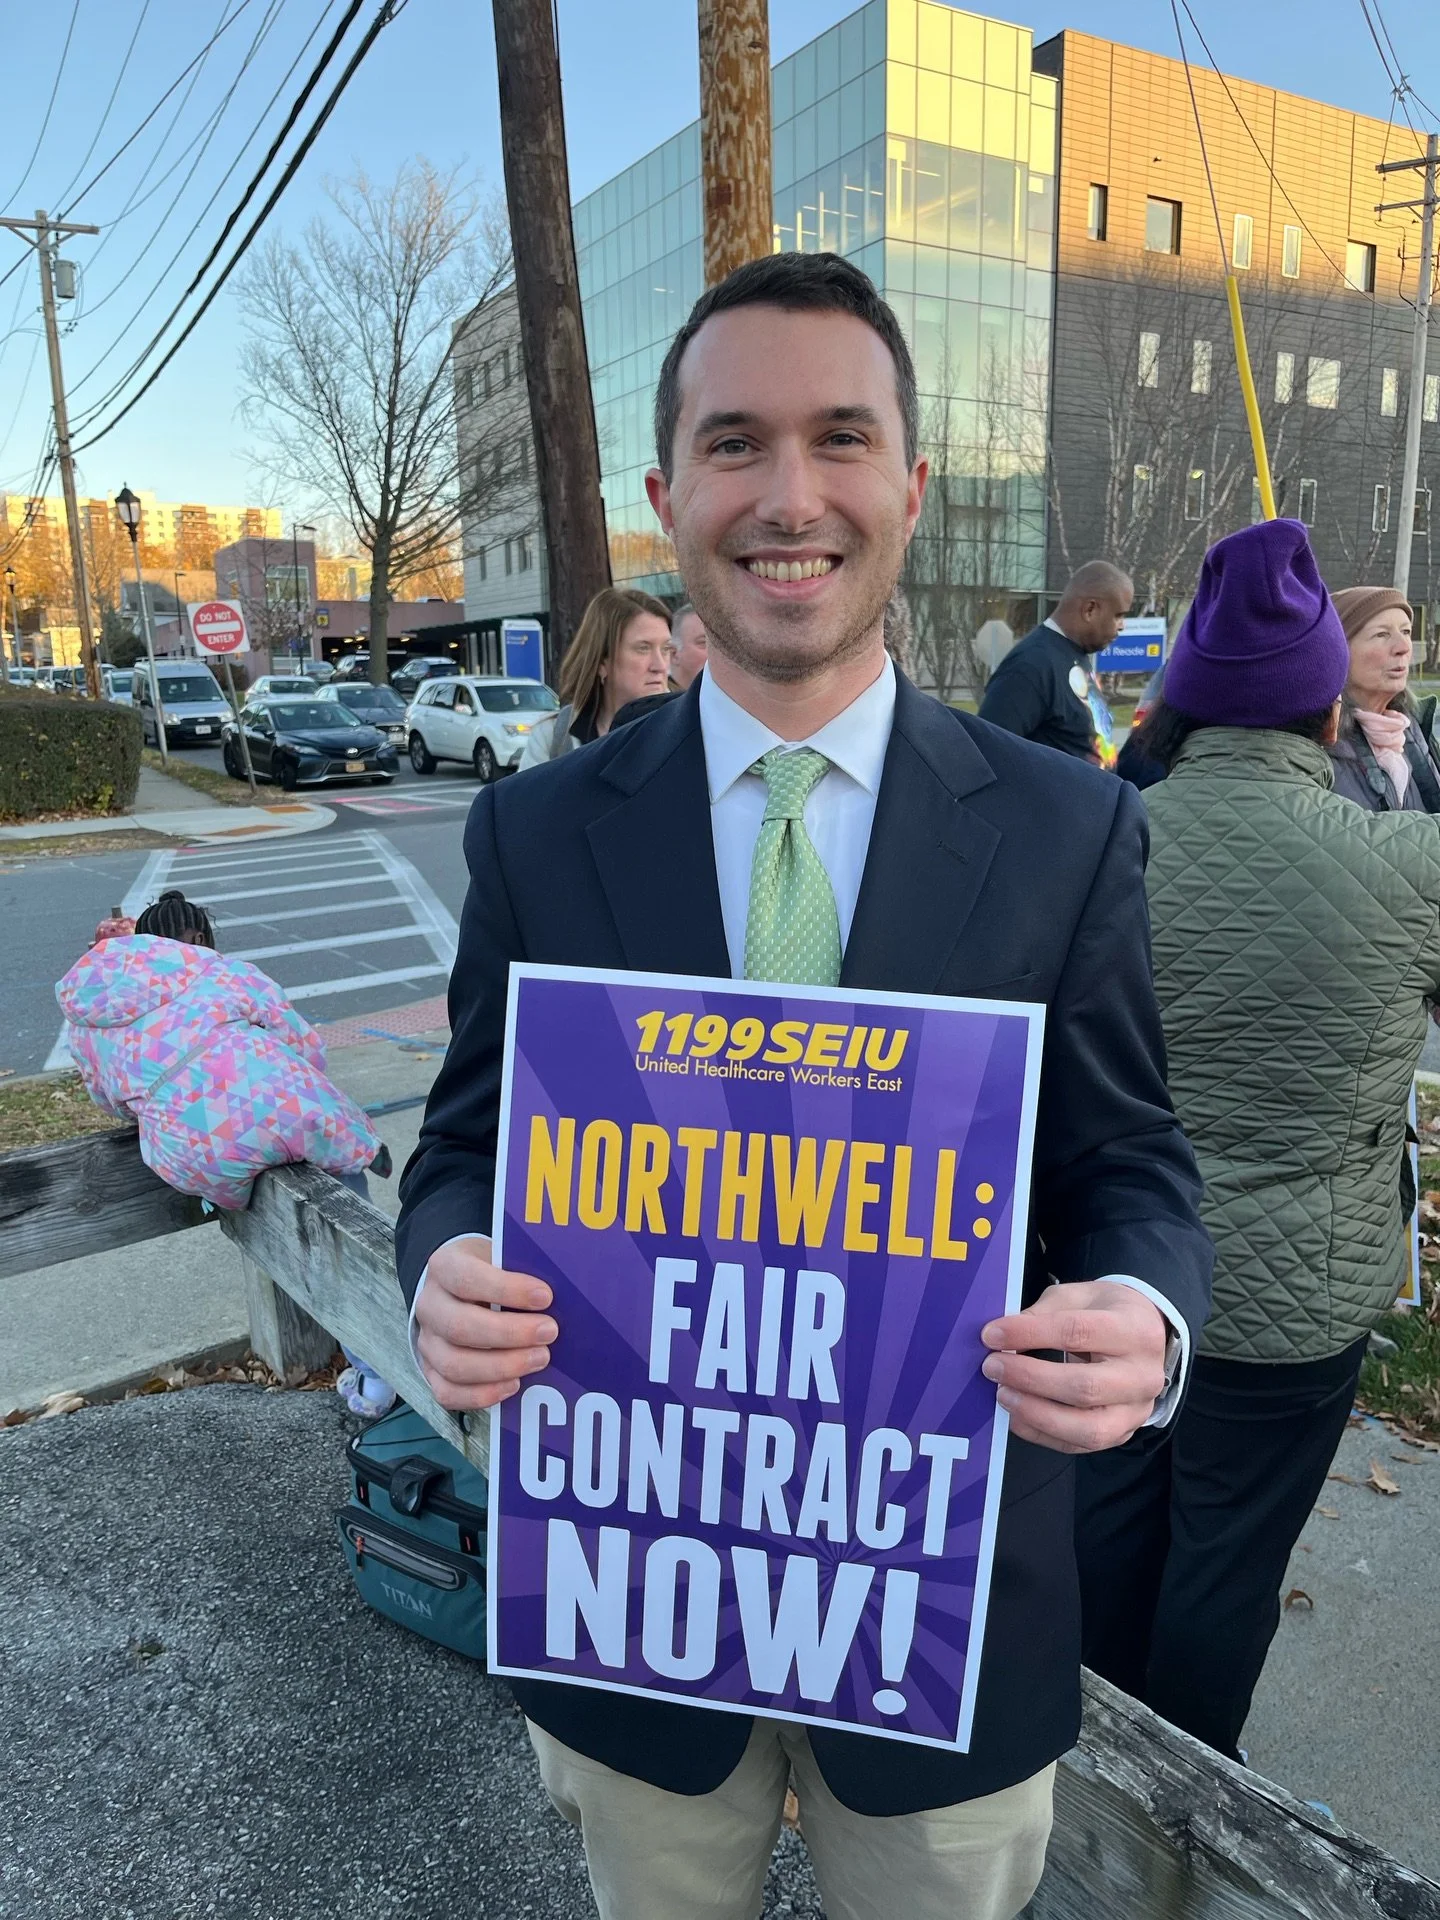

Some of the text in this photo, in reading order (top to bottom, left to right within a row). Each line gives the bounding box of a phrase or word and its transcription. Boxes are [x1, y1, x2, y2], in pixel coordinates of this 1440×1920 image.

[199, 610, 232, 622] DO NOT
[207, 633, 234, 645] ENTER
[1112, 646, 1145, 657] Reade
[635, 1011, 909, 1071] 1199SEIU
[635, 1055, 903, 1092] United Healthcare Workers East
[526, 1116, 993, 1260] NORTHWELL:
[648, 1256, 846, 1404] FAIR
[519, 1384, 970, 1557] CONTRACT
[380, 1581, 432, 1617] TITAN
[545, 1518, 921, 1716] NOW!
